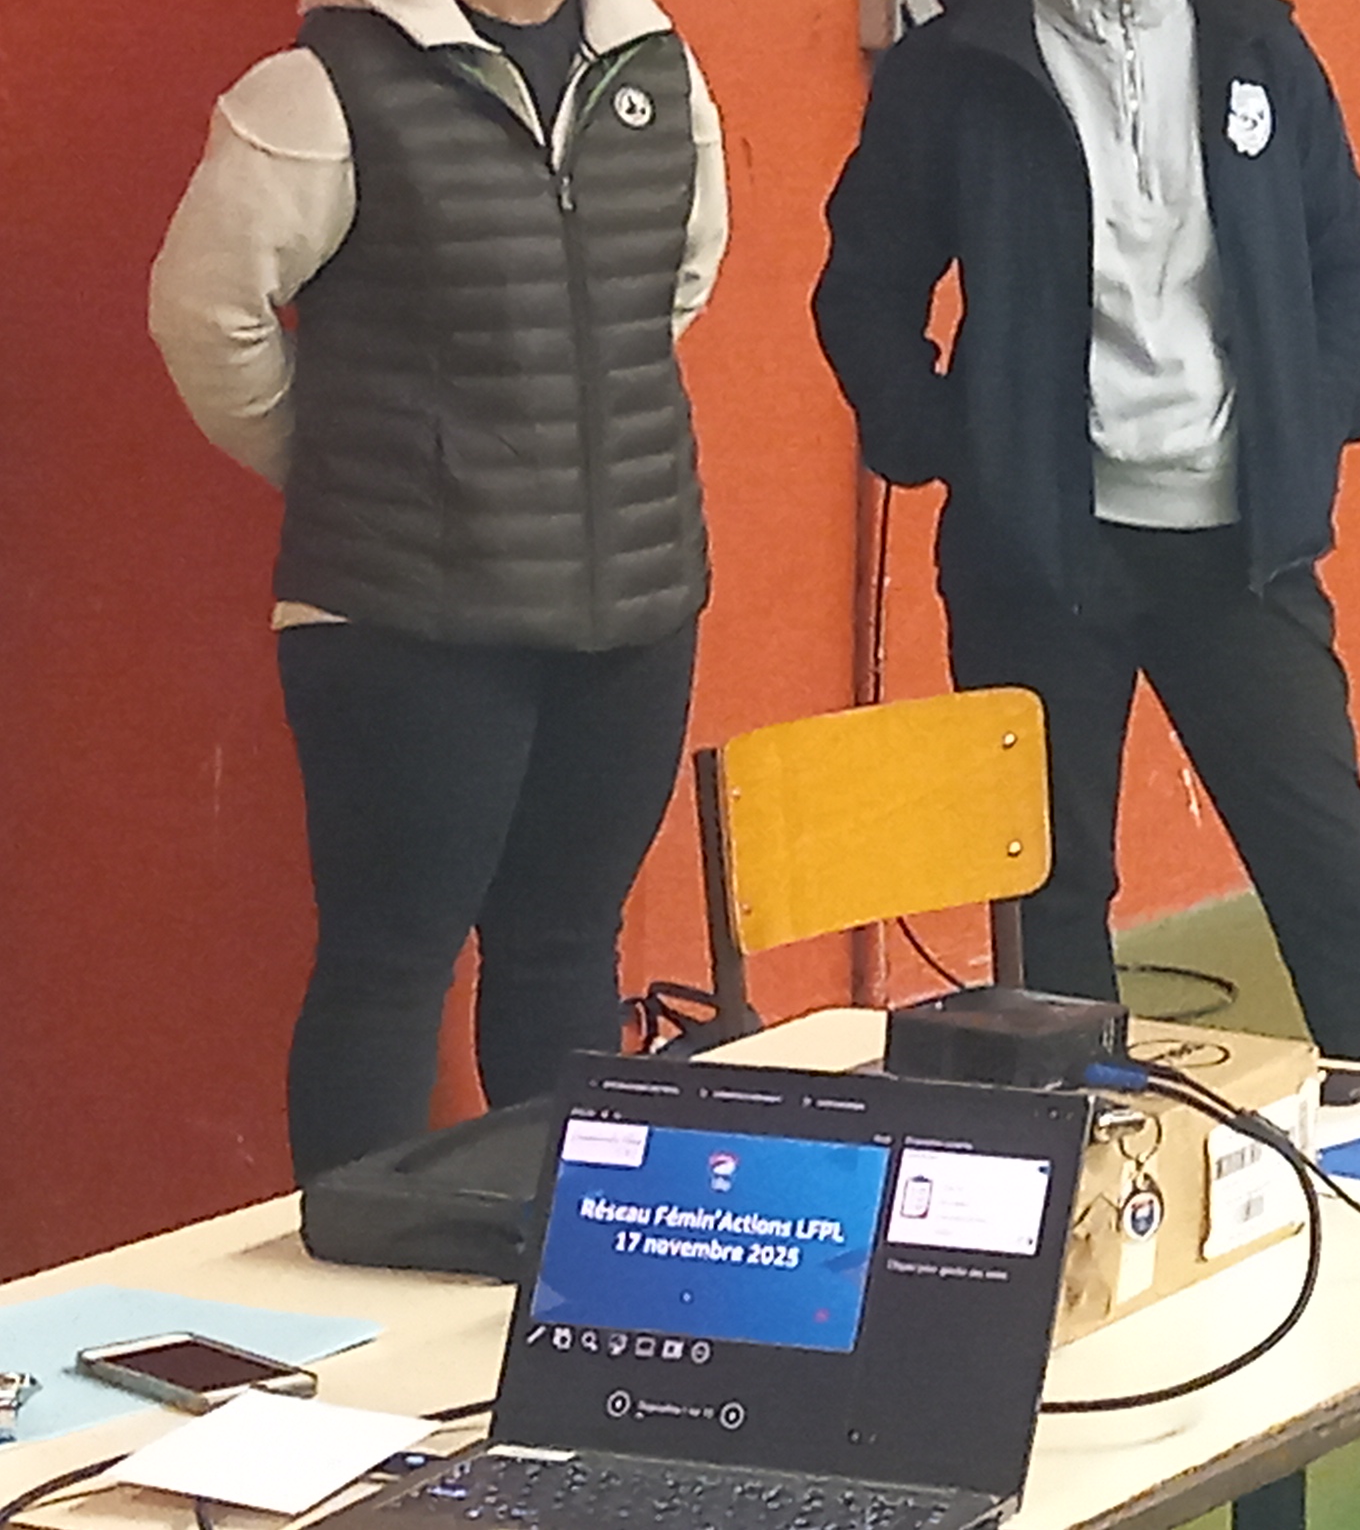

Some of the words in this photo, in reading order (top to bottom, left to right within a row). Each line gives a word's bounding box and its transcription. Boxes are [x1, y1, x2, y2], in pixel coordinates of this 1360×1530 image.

[580, 1197, 651, 1226] Réseau
[654, 1206, 792, 1238] Fémin'Actions
[796, 1218, 845, 1243] LFPL
[614, 1231, 642, 1253] 17
[643, 1237, 744, 1263] novembre
[747, 1243, 800, 1268] 2025
